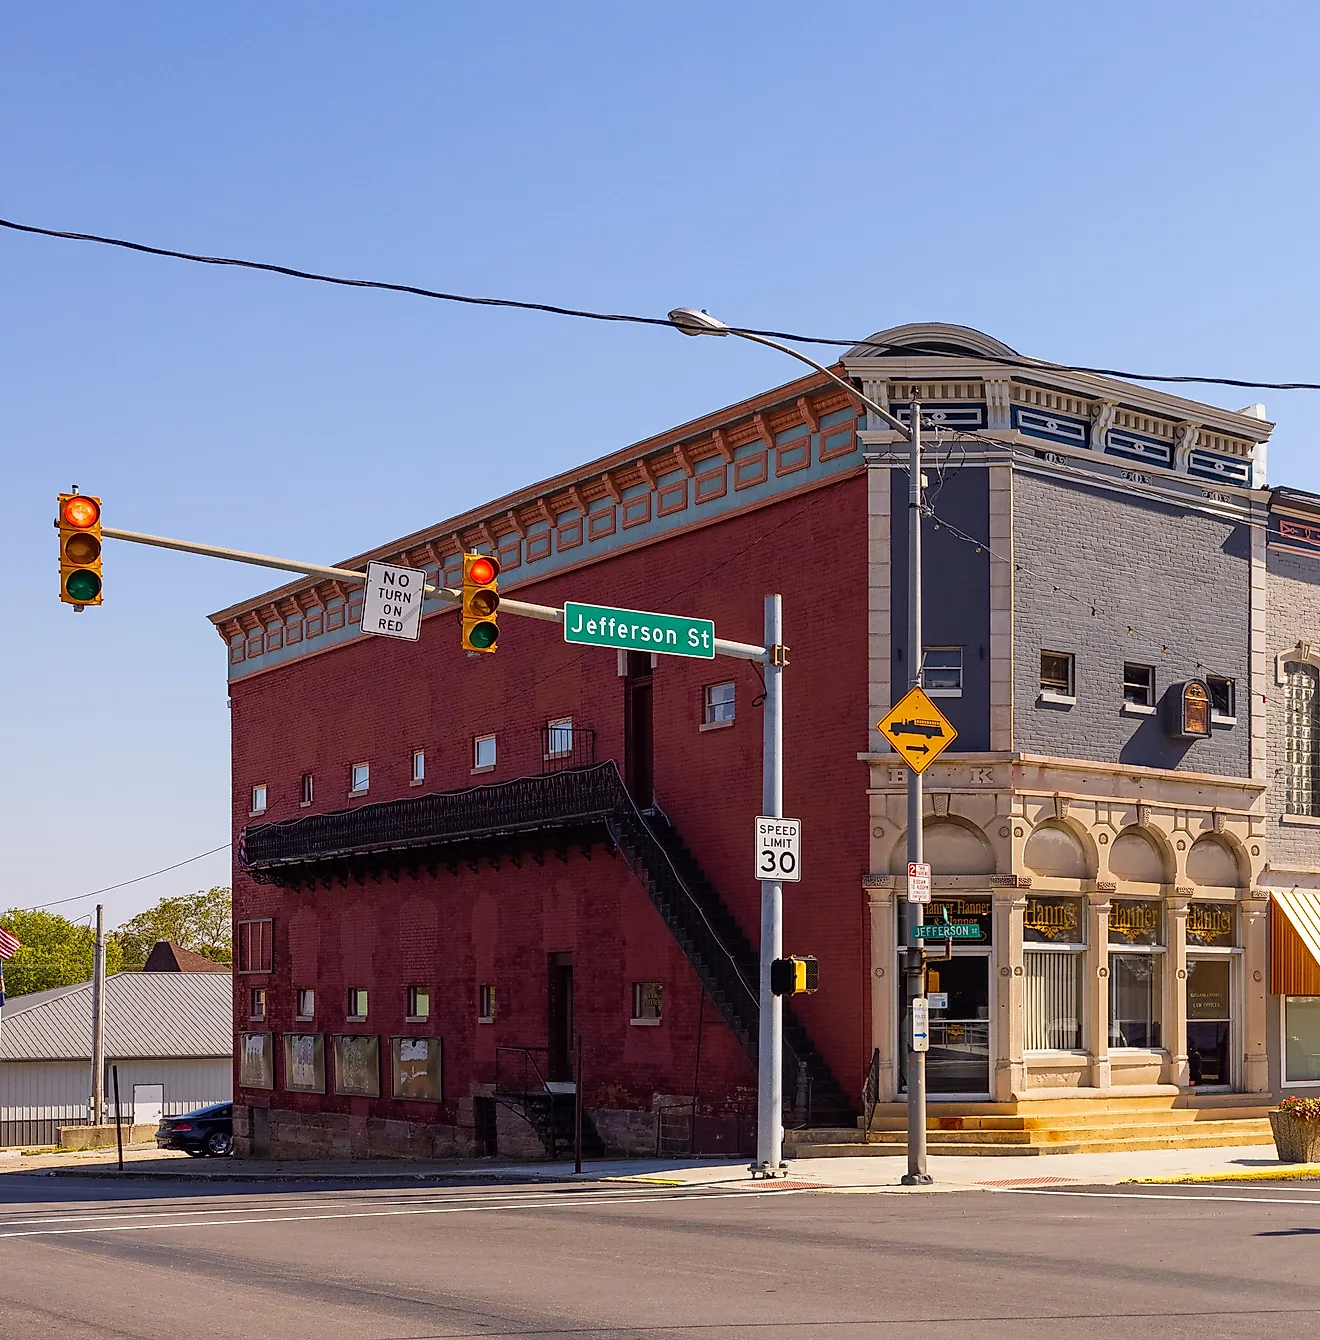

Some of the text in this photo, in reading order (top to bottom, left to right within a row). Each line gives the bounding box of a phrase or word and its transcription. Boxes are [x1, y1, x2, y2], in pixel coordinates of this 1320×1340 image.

[383, 571, 409, 587] NO
[378, 588, 411, 603] TURN
[383, 604, 402, 617] ON
[378, 618, 403, 632] RED
[571, 614, 709, 648] Jefferson St
[760, 824, 797, 836] SPEED
[763, 837, 792, 848] LIMIT
[761, 850, 796, 873] 30
[910, 865, 916, 876] 2
[957, 900, 990, 915] Hanner
[1023, 900, 1077, 925] Hanner
[1108, 902, 1157, 927] Hanner
[1187, 905, 1232, 930] Hanner
[915, 926, 969, 937] JEFFERSON
